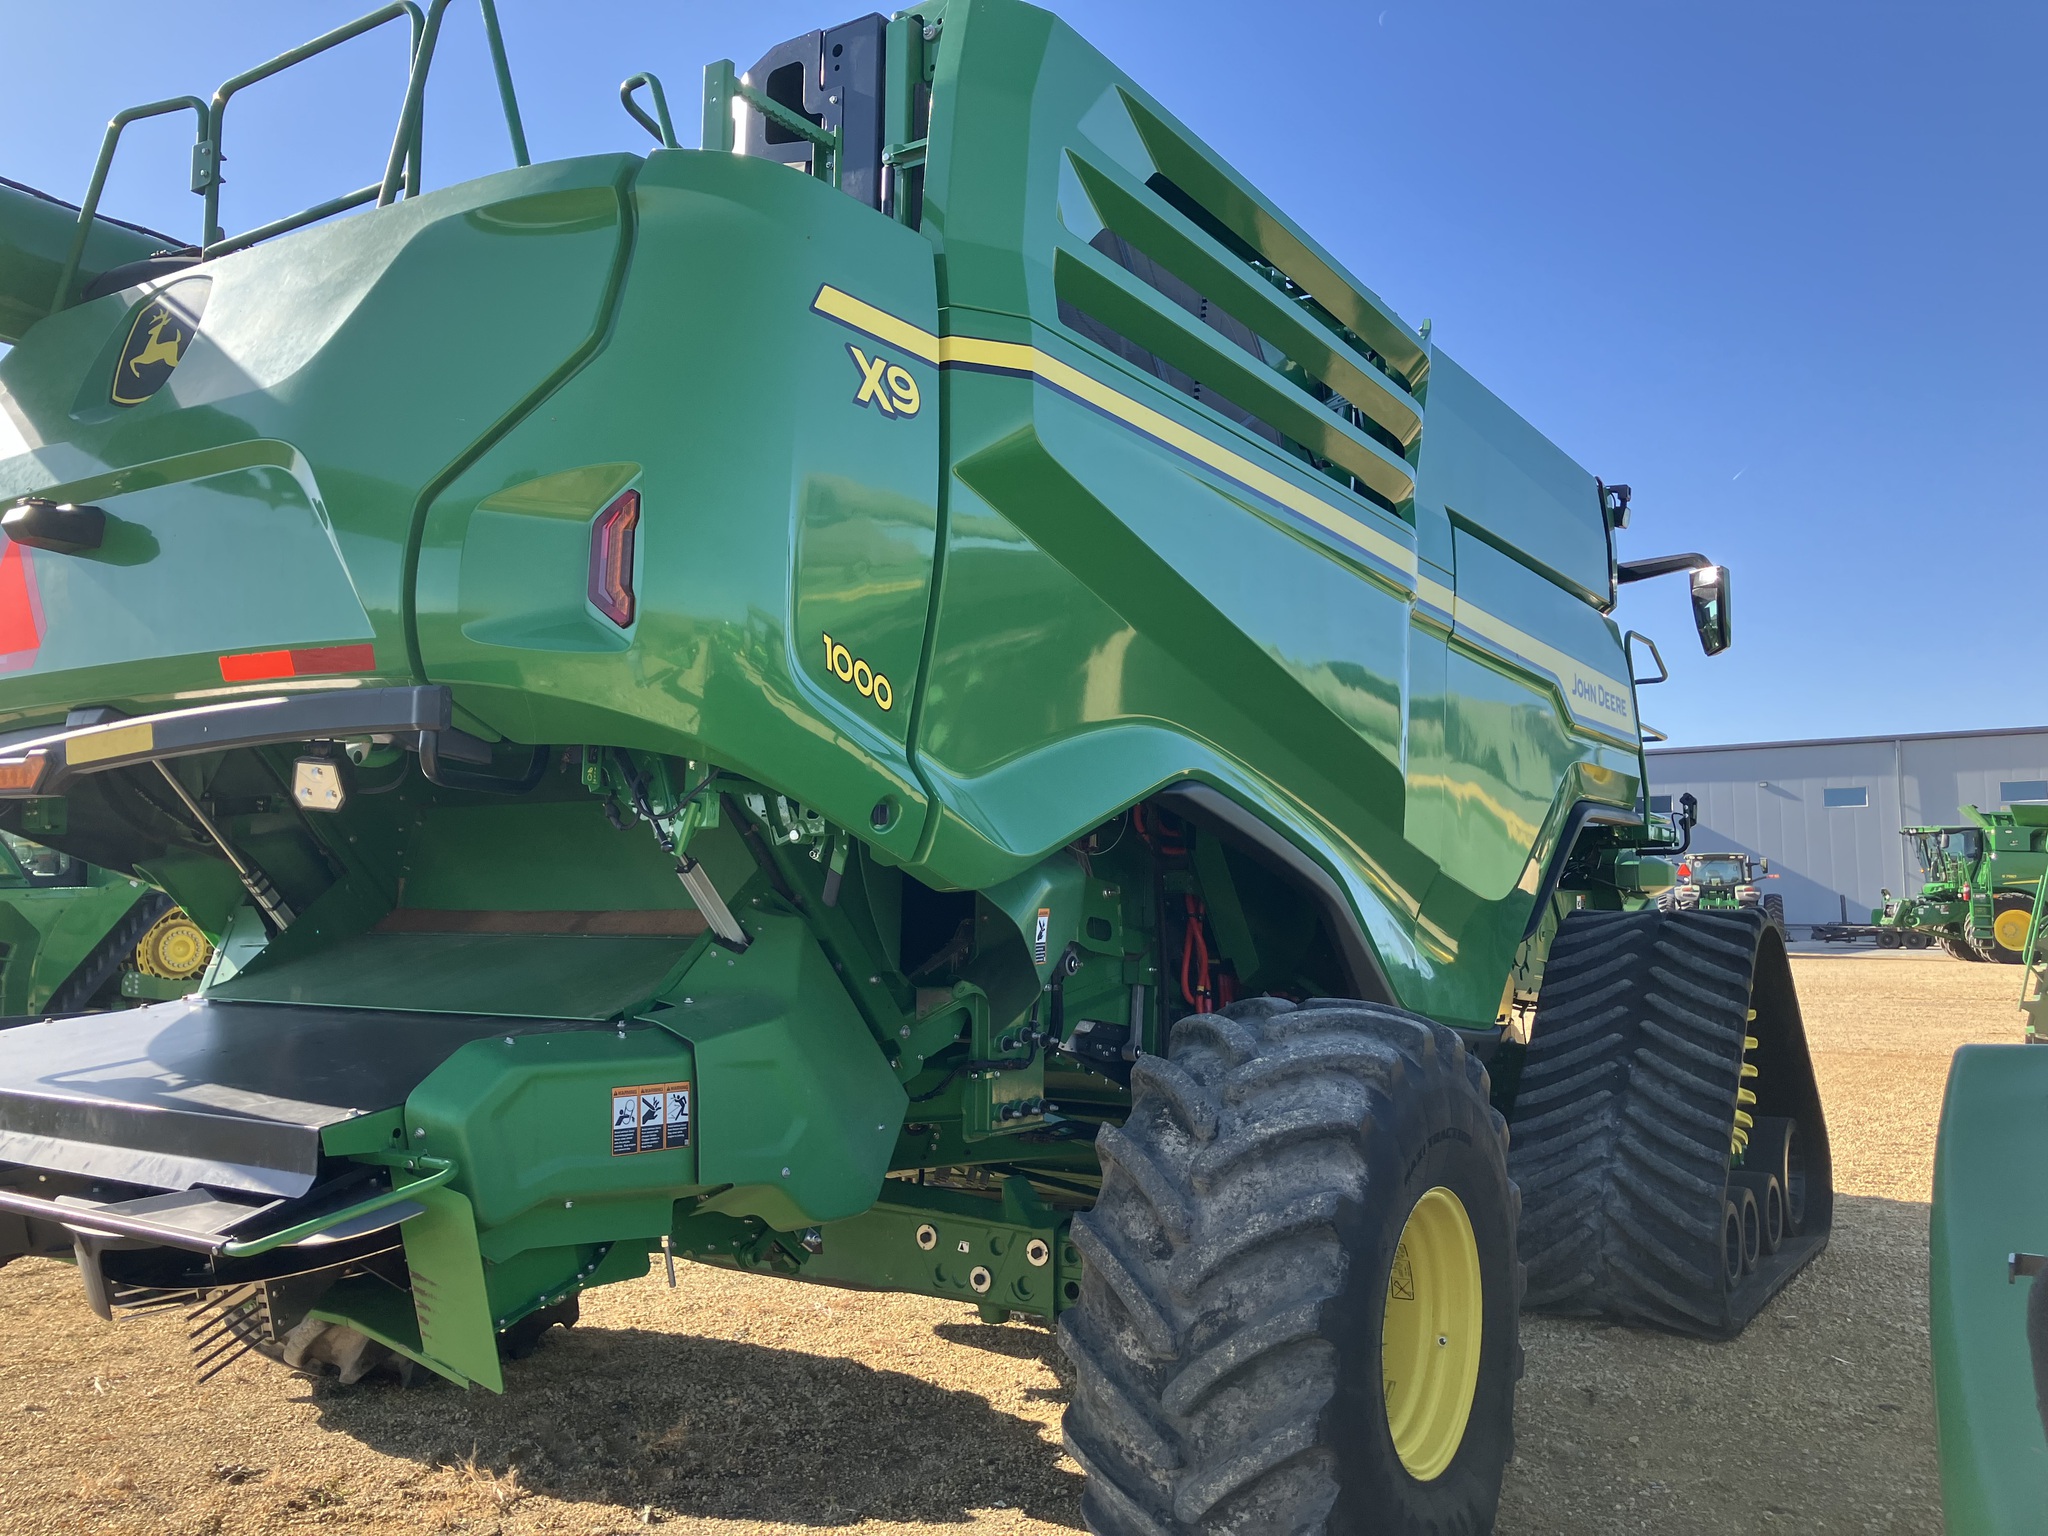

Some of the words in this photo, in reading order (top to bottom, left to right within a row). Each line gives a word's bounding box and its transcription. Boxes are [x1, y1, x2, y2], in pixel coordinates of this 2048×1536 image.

[845, 342, 921, 421] X9
[822, 631, 894, 712] 1000
[1572, 673, 1597, 704] JOHN
[1598, 684, 1627, 716] DEERE
